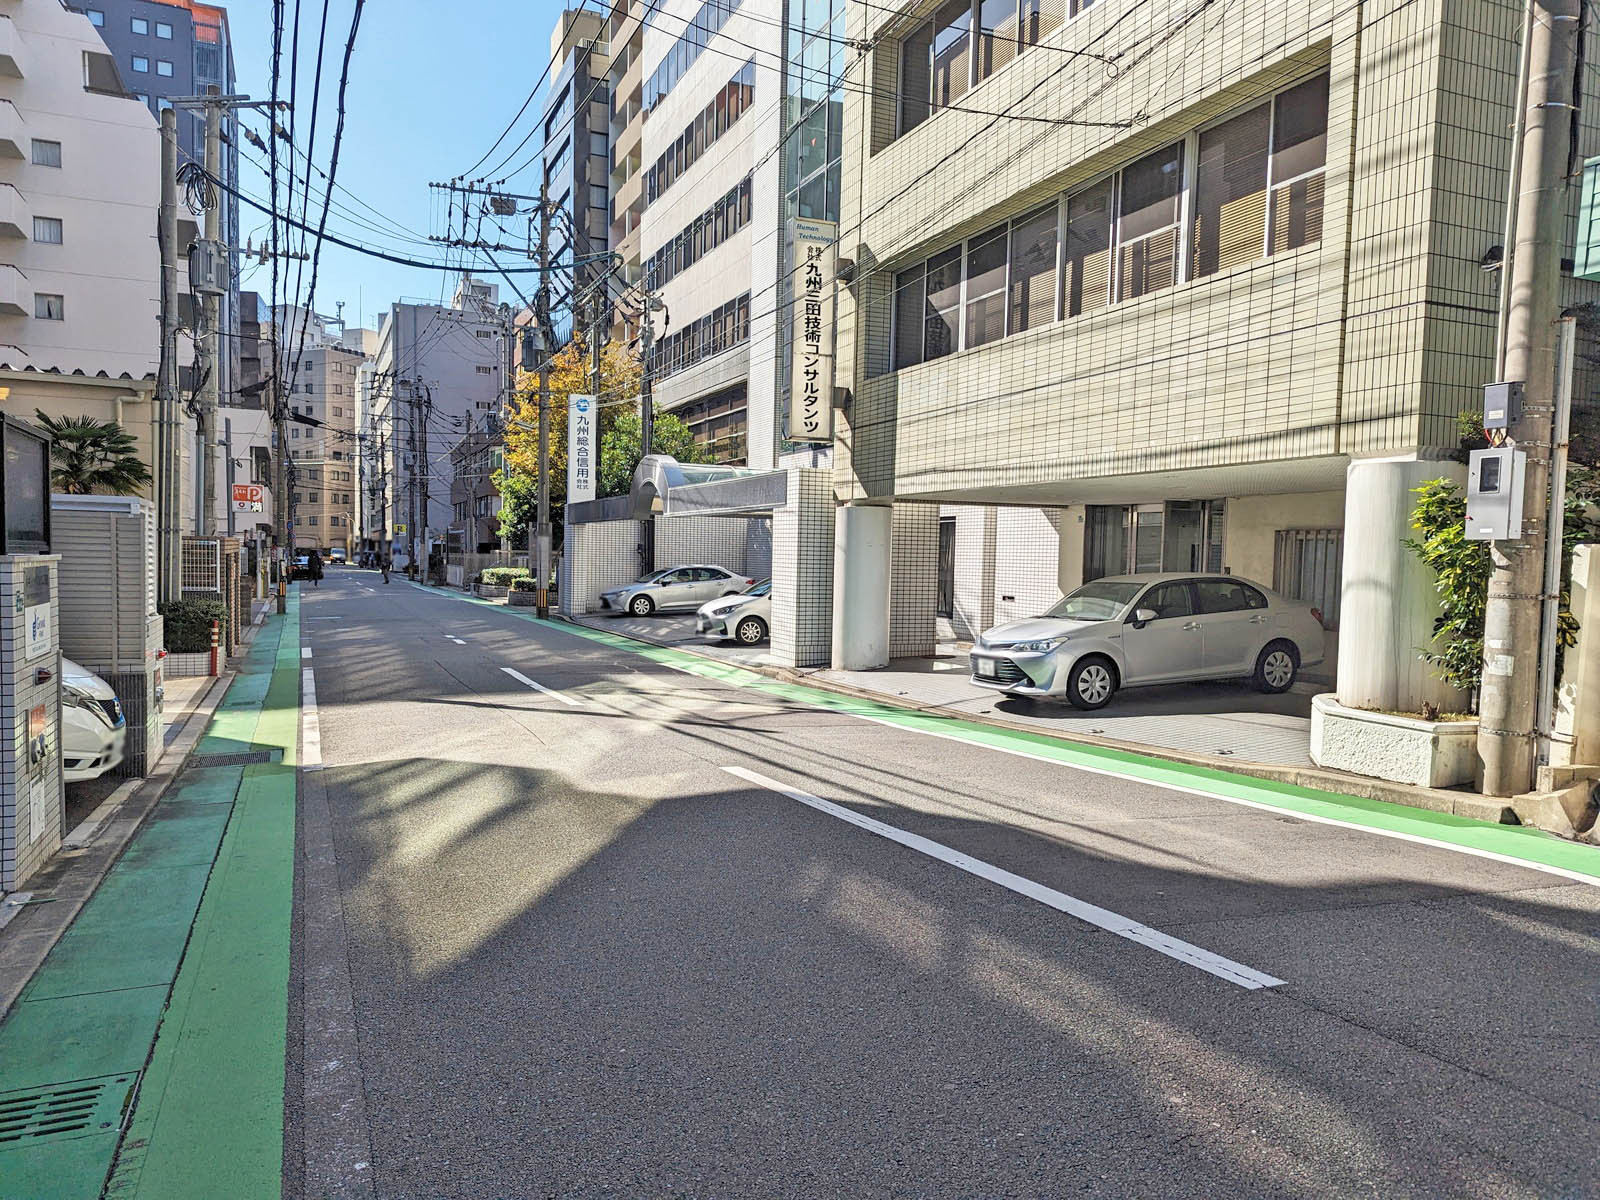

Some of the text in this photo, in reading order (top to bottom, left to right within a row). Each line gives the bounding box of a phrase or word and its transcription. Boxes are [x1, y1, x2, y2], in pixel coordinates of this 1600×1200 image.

[796, 223, 819, 232] Human
[799, 232, 834, 244] Technology
[576, 415, 590, 478] 九州総合信用
